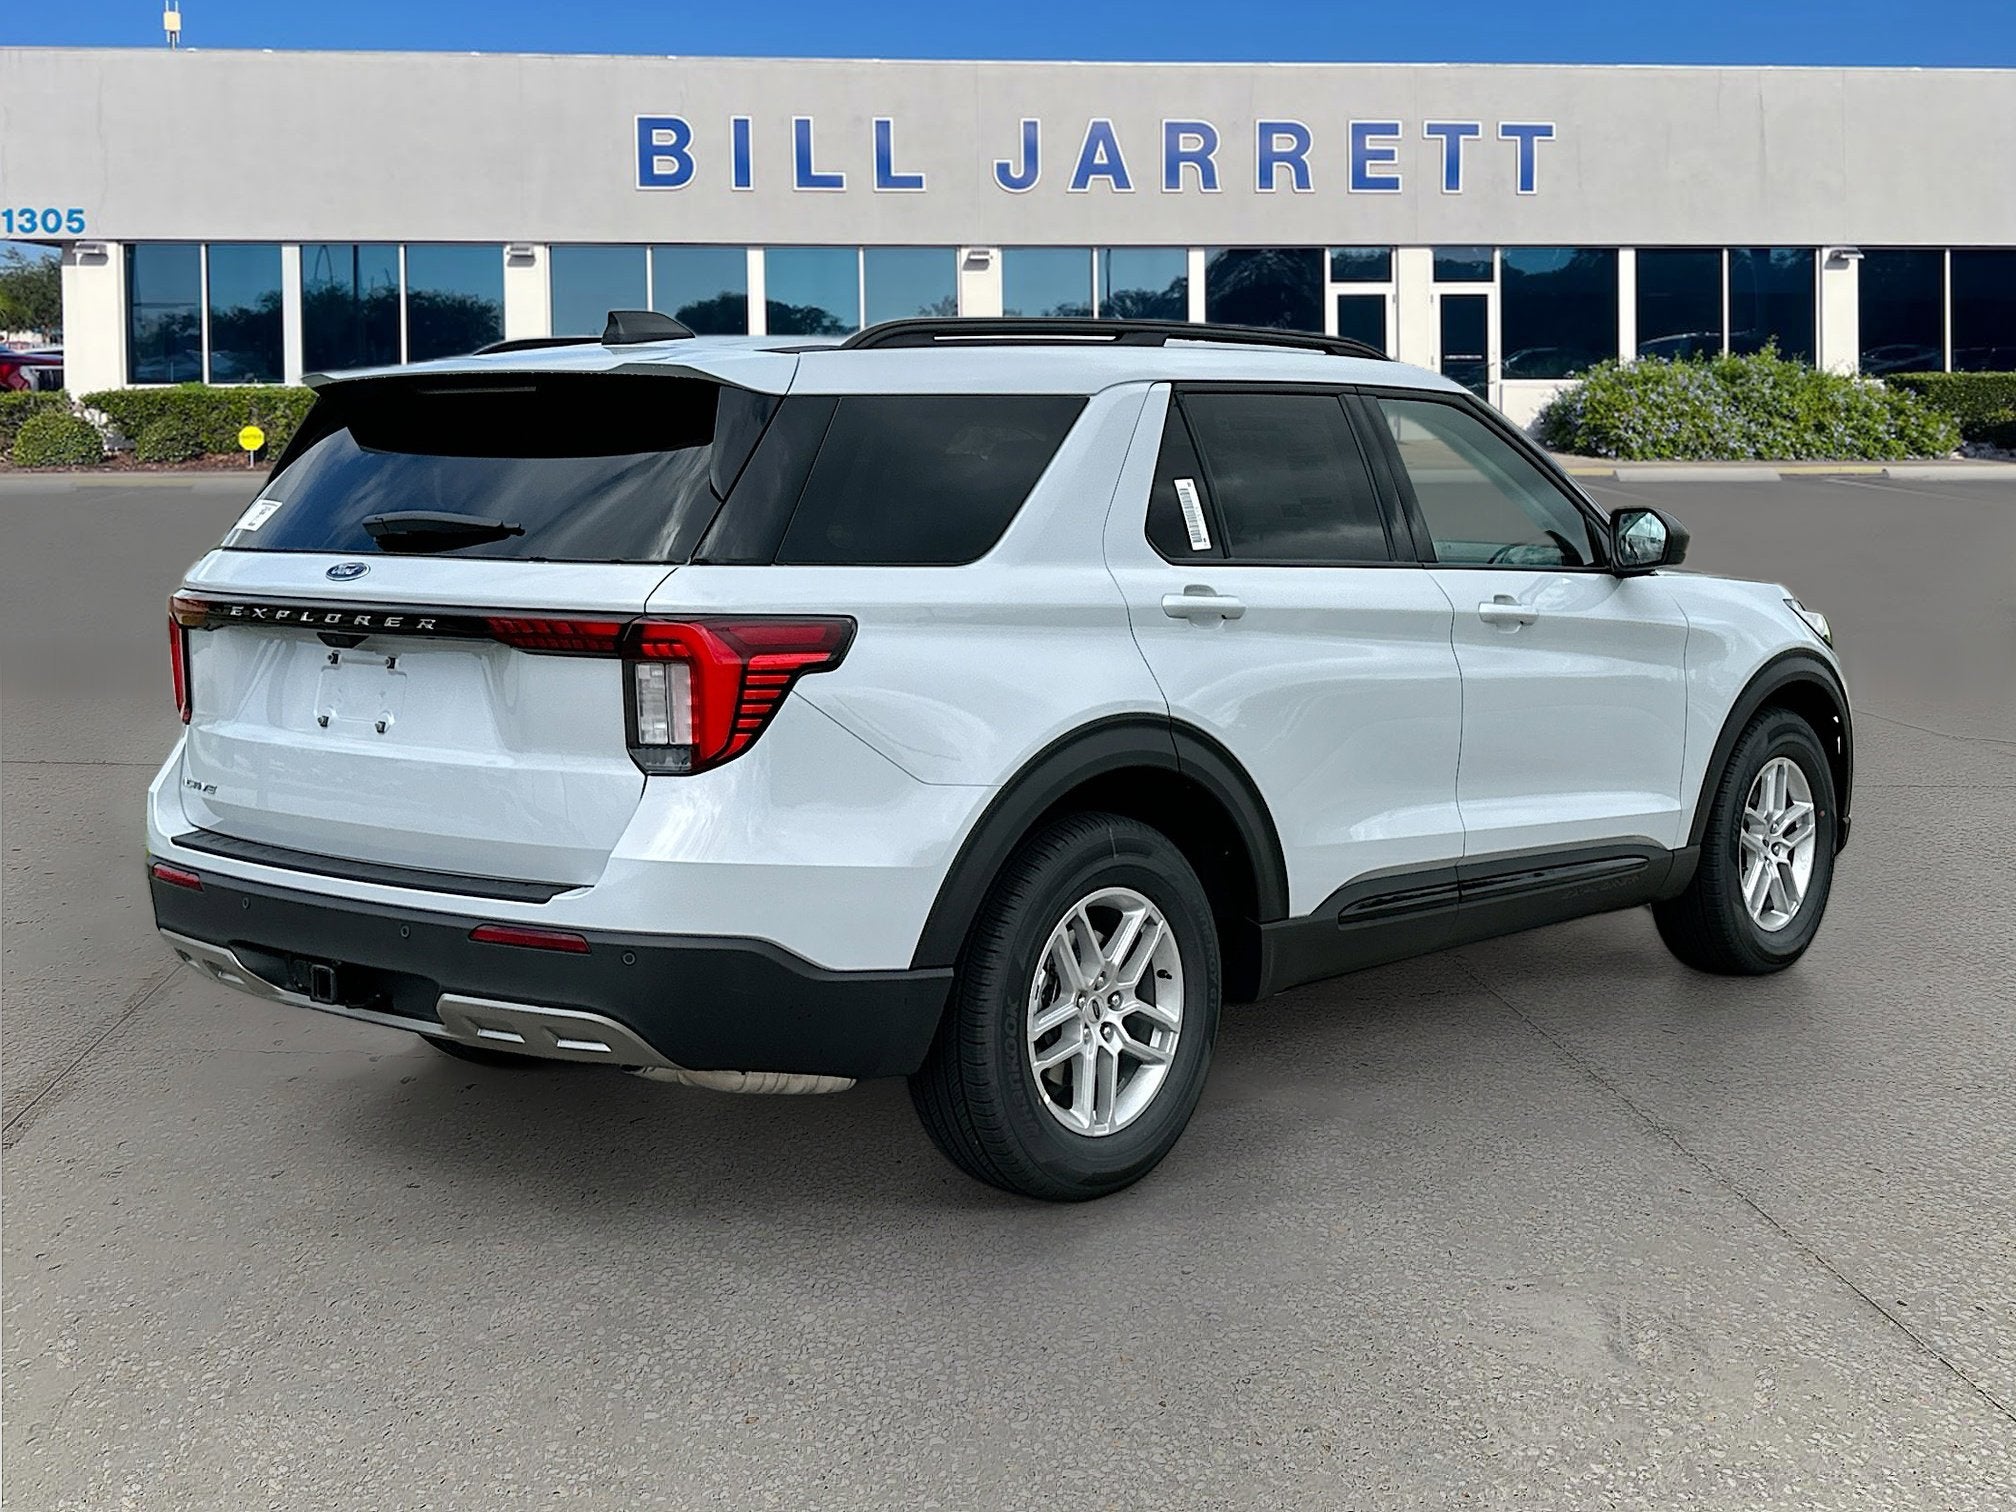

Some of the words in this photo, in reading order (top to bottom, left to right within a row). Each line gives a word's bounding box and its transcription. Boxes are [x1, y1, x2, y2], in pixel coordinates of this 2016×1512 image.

[635, 115, 925, 191] BILL
[994, 117, 1557, 195] JARRETT
[1, 207, 85, 234] 1305
[229, 606, 437, 630] EXPLORER
